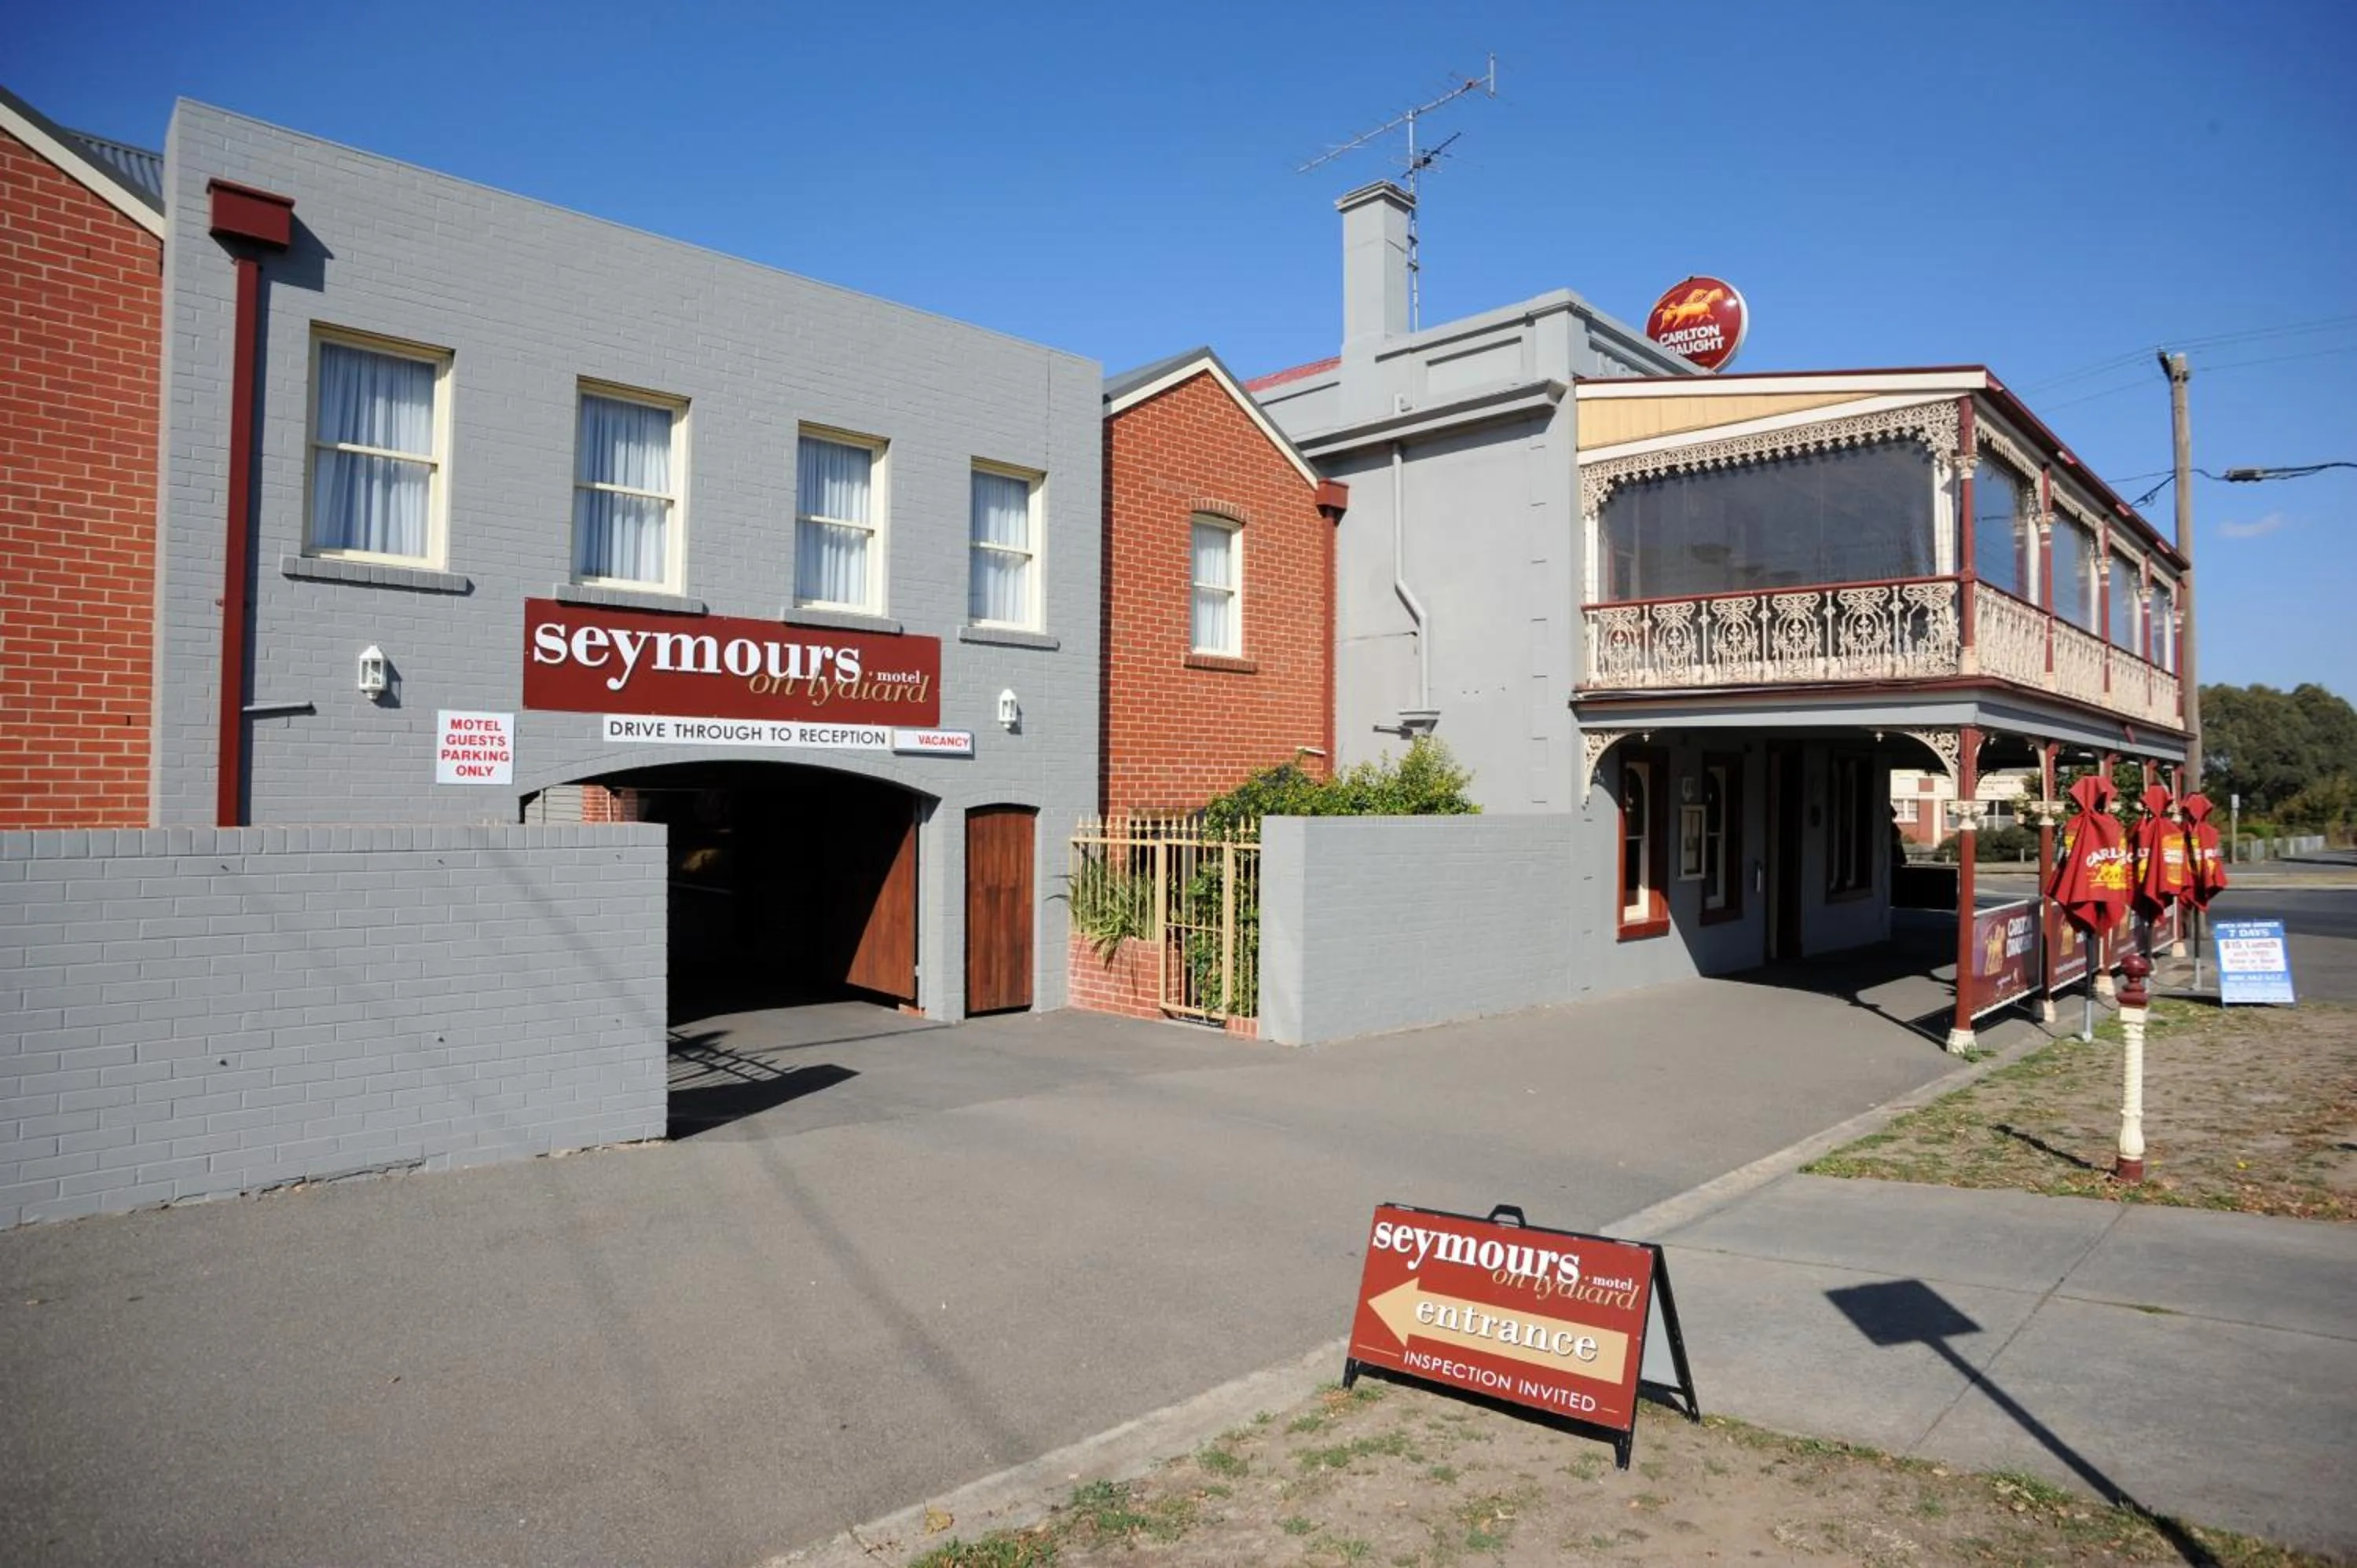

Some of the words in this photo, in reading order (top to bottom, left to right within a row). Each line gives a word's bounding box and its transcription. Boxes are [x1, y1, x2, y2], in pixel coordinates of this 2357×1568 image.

[1659, 324, 1721, 346] CARLTON
[533, 622, 862, 691] seymours
[749, 673, 796, 695] on
[876, 670, 922, 684] motel
[450, 718, 502, 731] MOTEL
[610, 720, 666, 738] DRIVE
[673, 723, 762, 740] THROUGH
[770, 727, 792, 742] TO
[799, 728, 885, 745] RECEPTION
[445, 733, 507, 747] GUESTS
[918, 734, 970, 748] VACANCY
[441, 749, 510, 762] PARKING
[456, 764, 494, 777] ONLY
[2238, 928, 2270, 937] DAYS
[1373, 1222, 1581, 1284] seymours
[1492, 1268, 1526, 1288] on
[1592, 1275, 1633, 1291] motel
[1415, 1300, 1600, 1362] entrance
[1403, 1350, 1512, 1391] INSPECTION
[1518, 1378, 1596, 1412] INVITED
